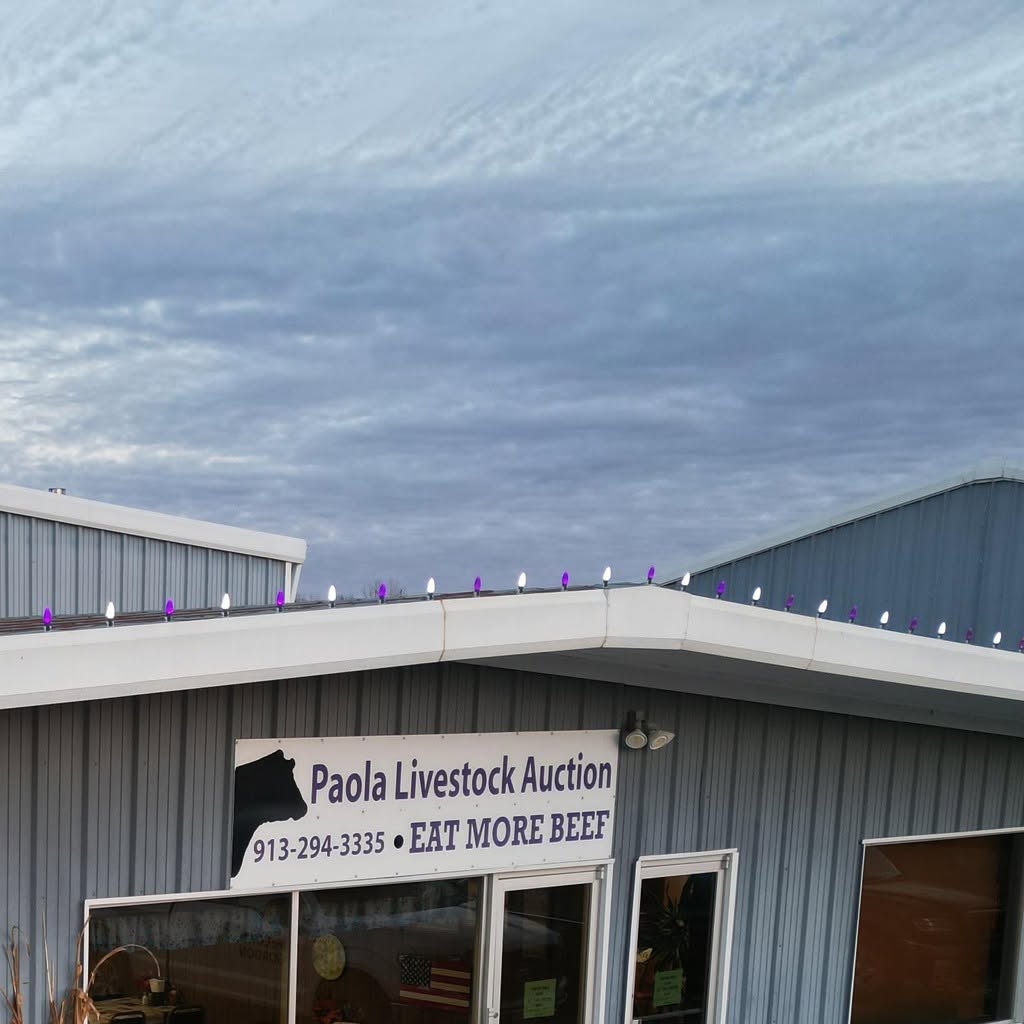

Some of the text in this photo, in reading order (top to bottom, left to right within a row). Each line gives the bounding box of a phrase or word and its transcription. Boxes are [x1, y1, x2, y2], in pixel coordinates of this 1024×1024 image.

[311, 752, 612, 805] Paola Livestock Auction
[252, 810, 610, 863] 913-294-3335 EAT MORE BEEF
